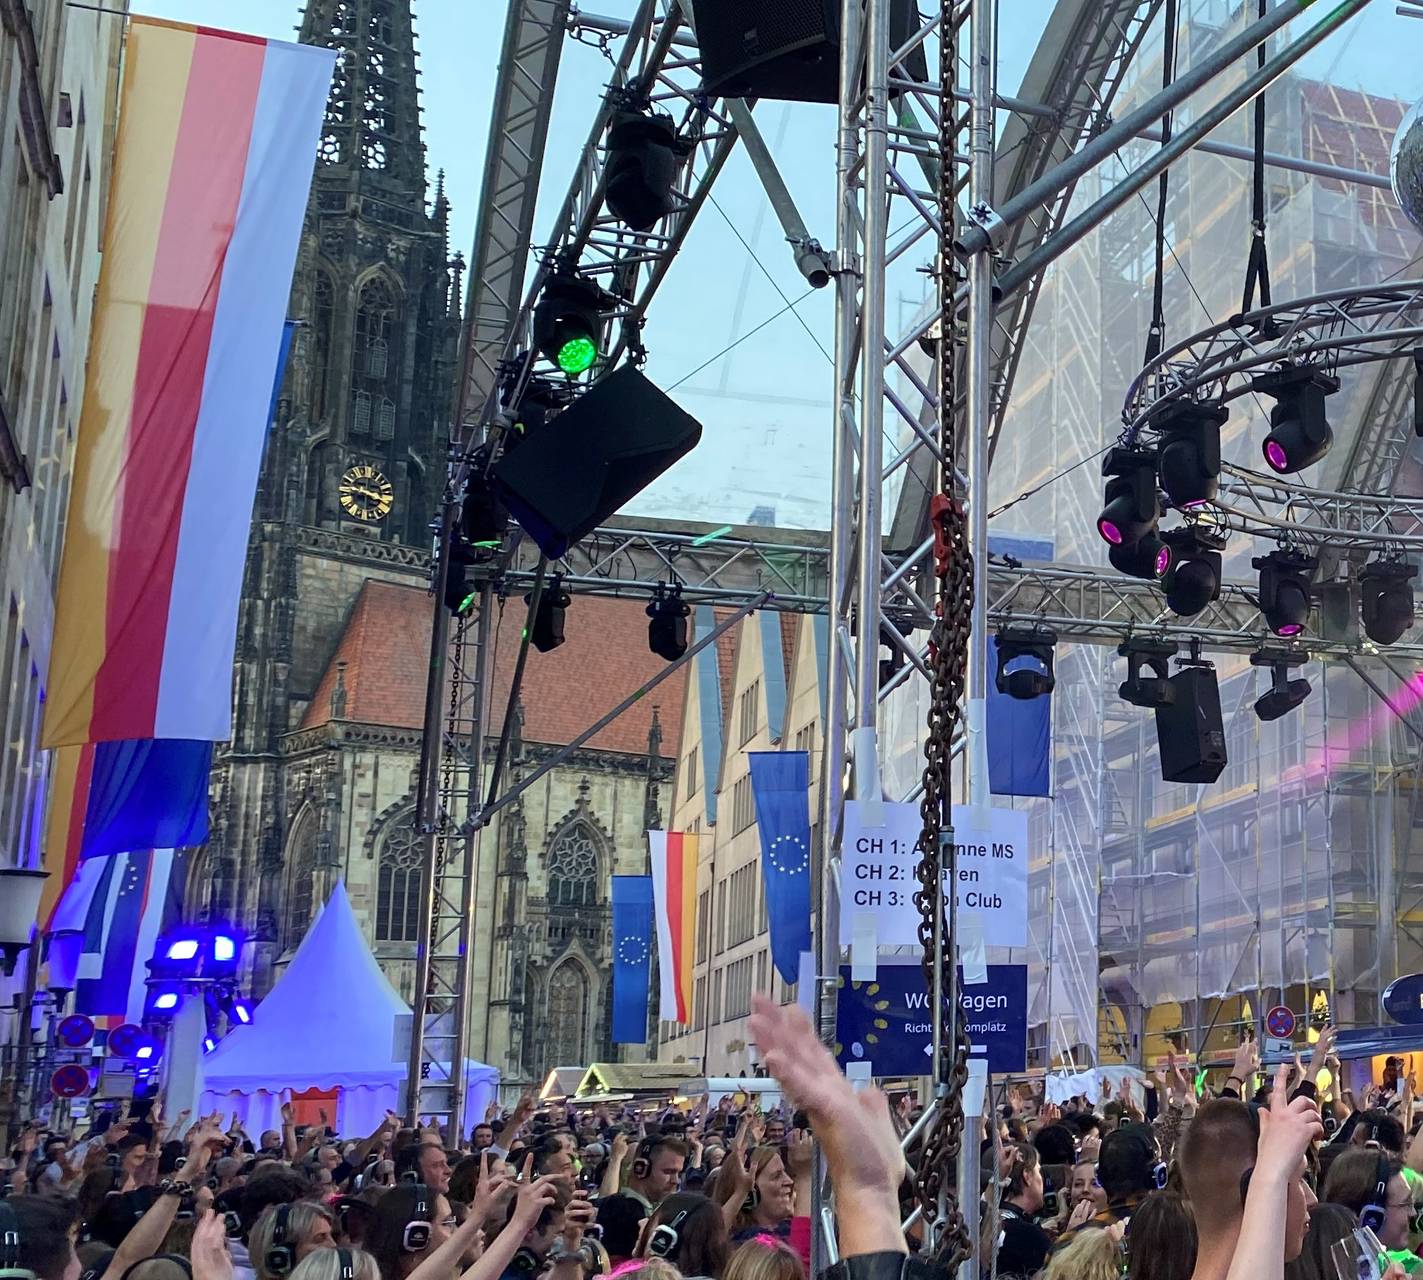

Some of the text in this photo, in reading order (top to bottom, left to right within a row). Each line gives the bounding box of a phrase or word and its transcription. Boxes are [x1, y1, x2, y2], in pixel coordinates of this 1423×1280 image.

[856, 838, 1014, 859] CH 1: Anne MS
[855, 864, 882, 880] CH
[888, 865, 905, 880] 2:
[854, 891, 882, 906] CH
[888, 891, 904, 906] 3:
[965, 892, 1002, 909] Club
[958, 1022, 1007, 1034] omplatz
